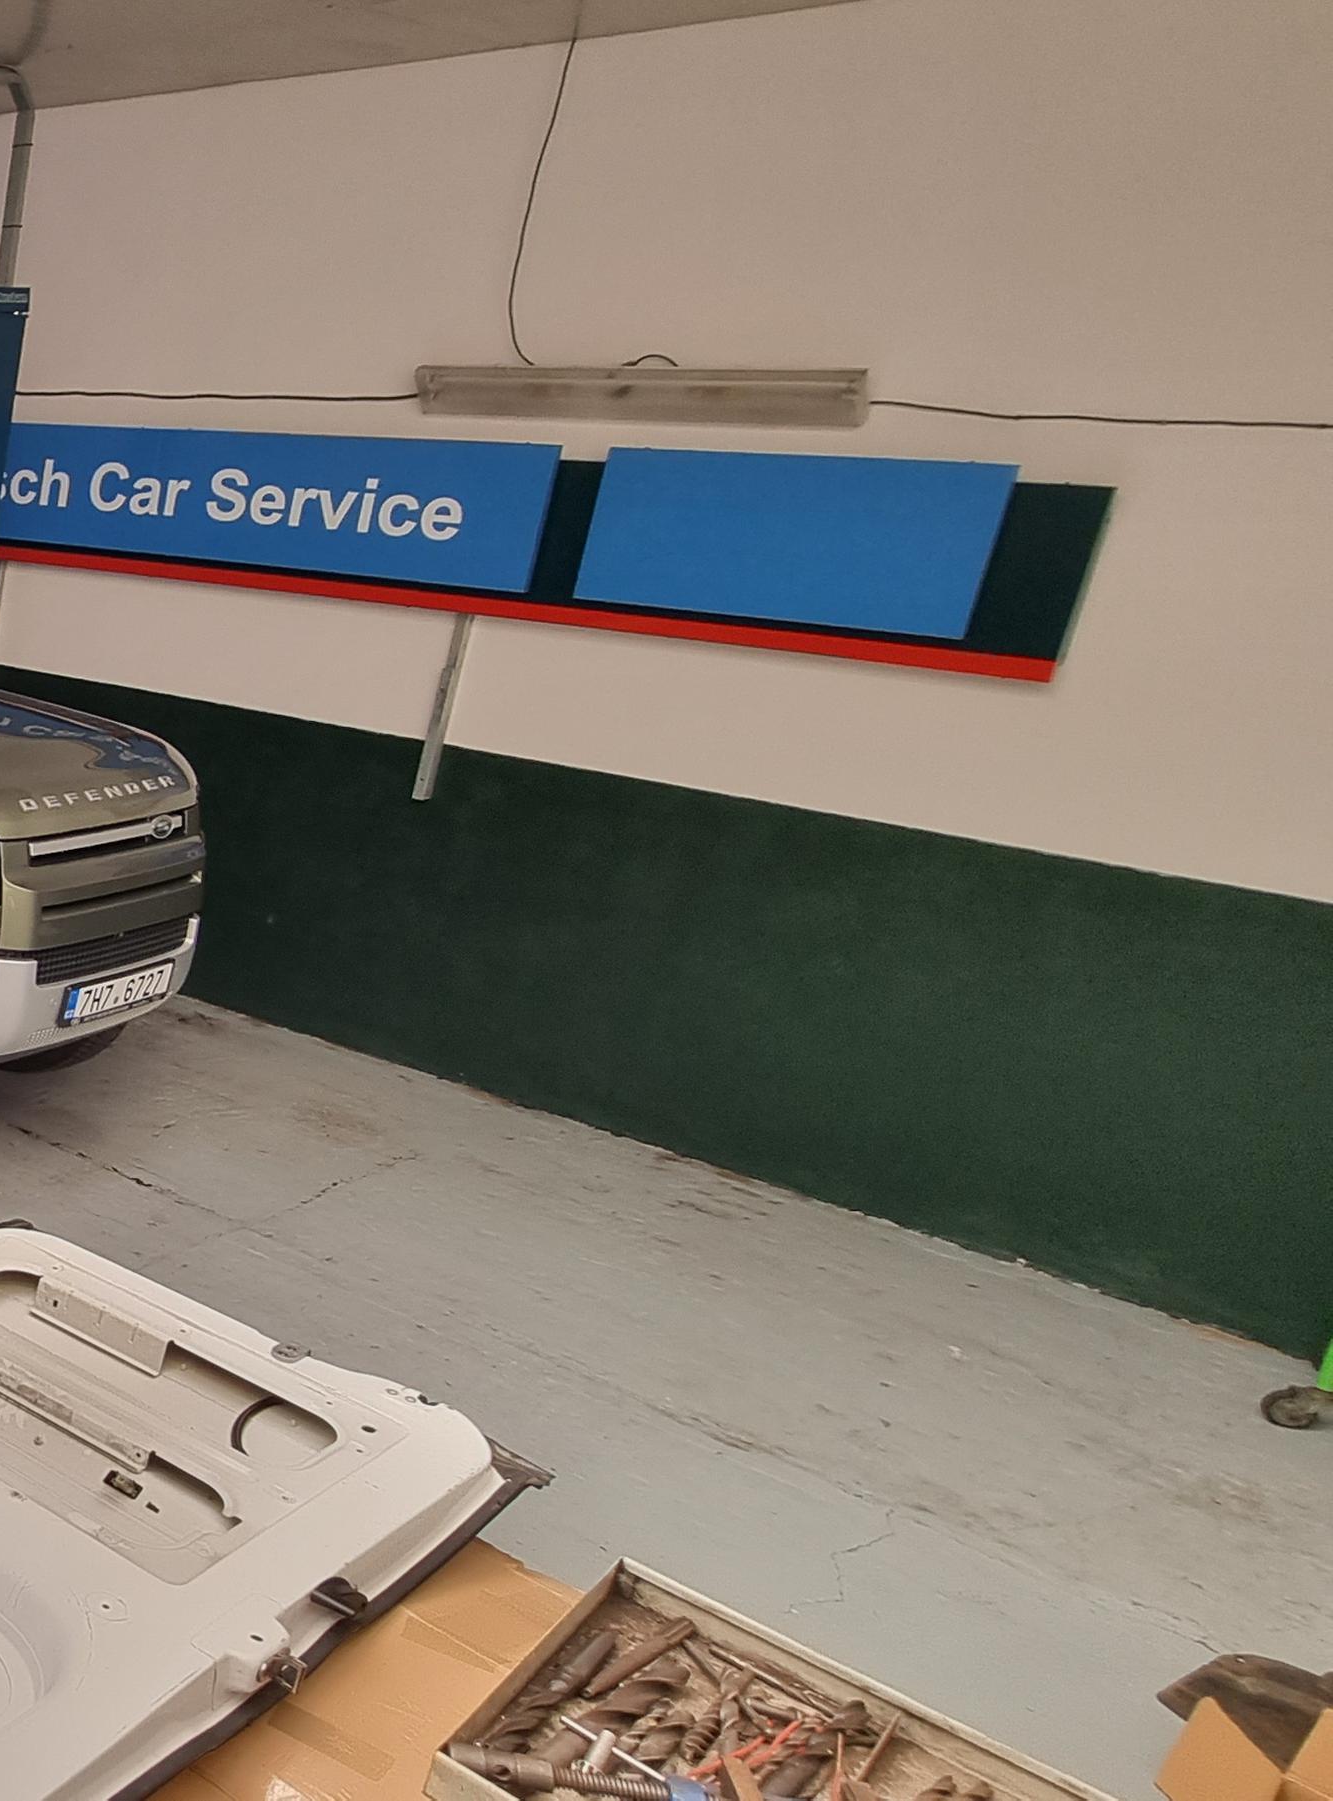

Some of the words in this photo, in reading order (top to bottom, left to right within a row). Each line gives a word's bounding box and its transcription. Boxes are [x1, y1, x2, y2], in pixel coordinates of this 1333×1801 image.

[89, 461, 191, 517] Car
[205, 468, 463, 541] Service
[19, 775, 176, 812] DEFENDER
[79, 984, 114, 1015] 7H7
[123, 969, 164, 1003] 6727
